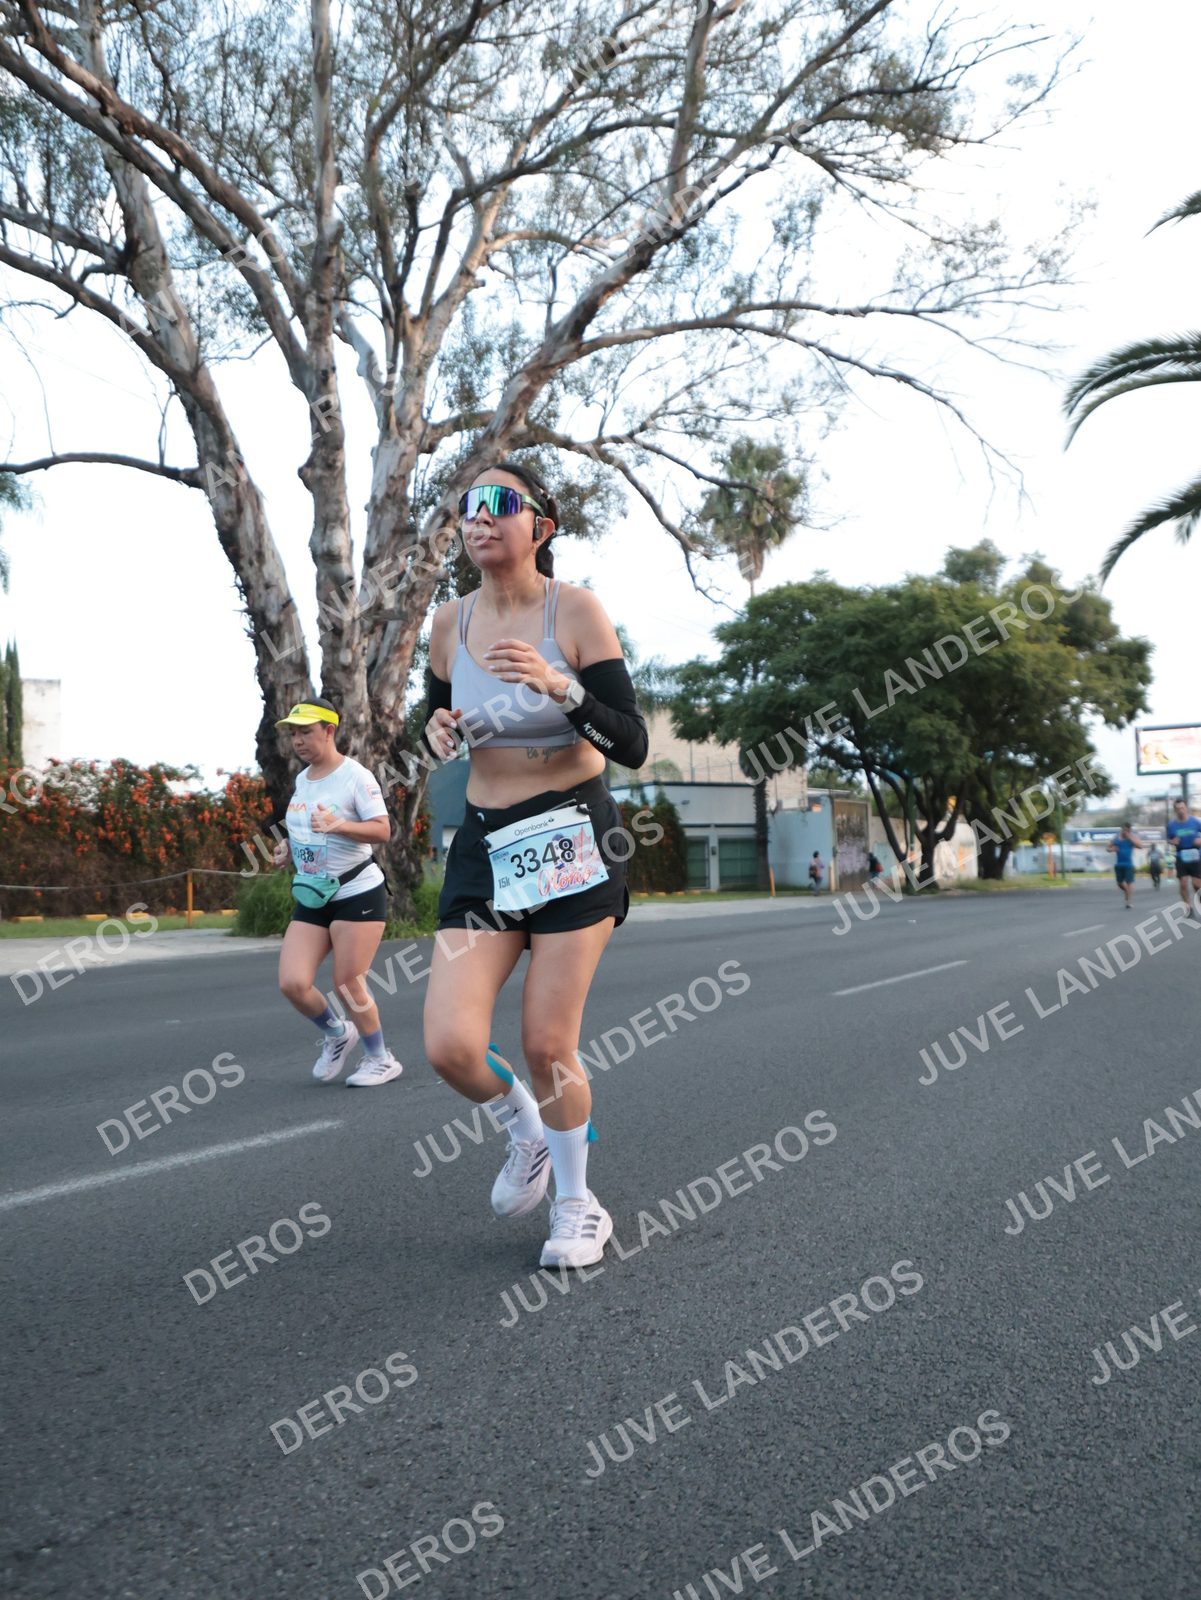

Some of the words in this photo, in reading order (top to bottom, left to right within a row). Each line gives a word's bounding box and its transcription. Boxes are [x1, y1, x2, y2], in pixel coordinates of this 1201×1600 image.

[583, 722, 614, 749] KIPRUN
[514, 819, 549, 837] Openbank
[510, 838, 576, 879] 3348
[498, 876, 511, 889] 15k
